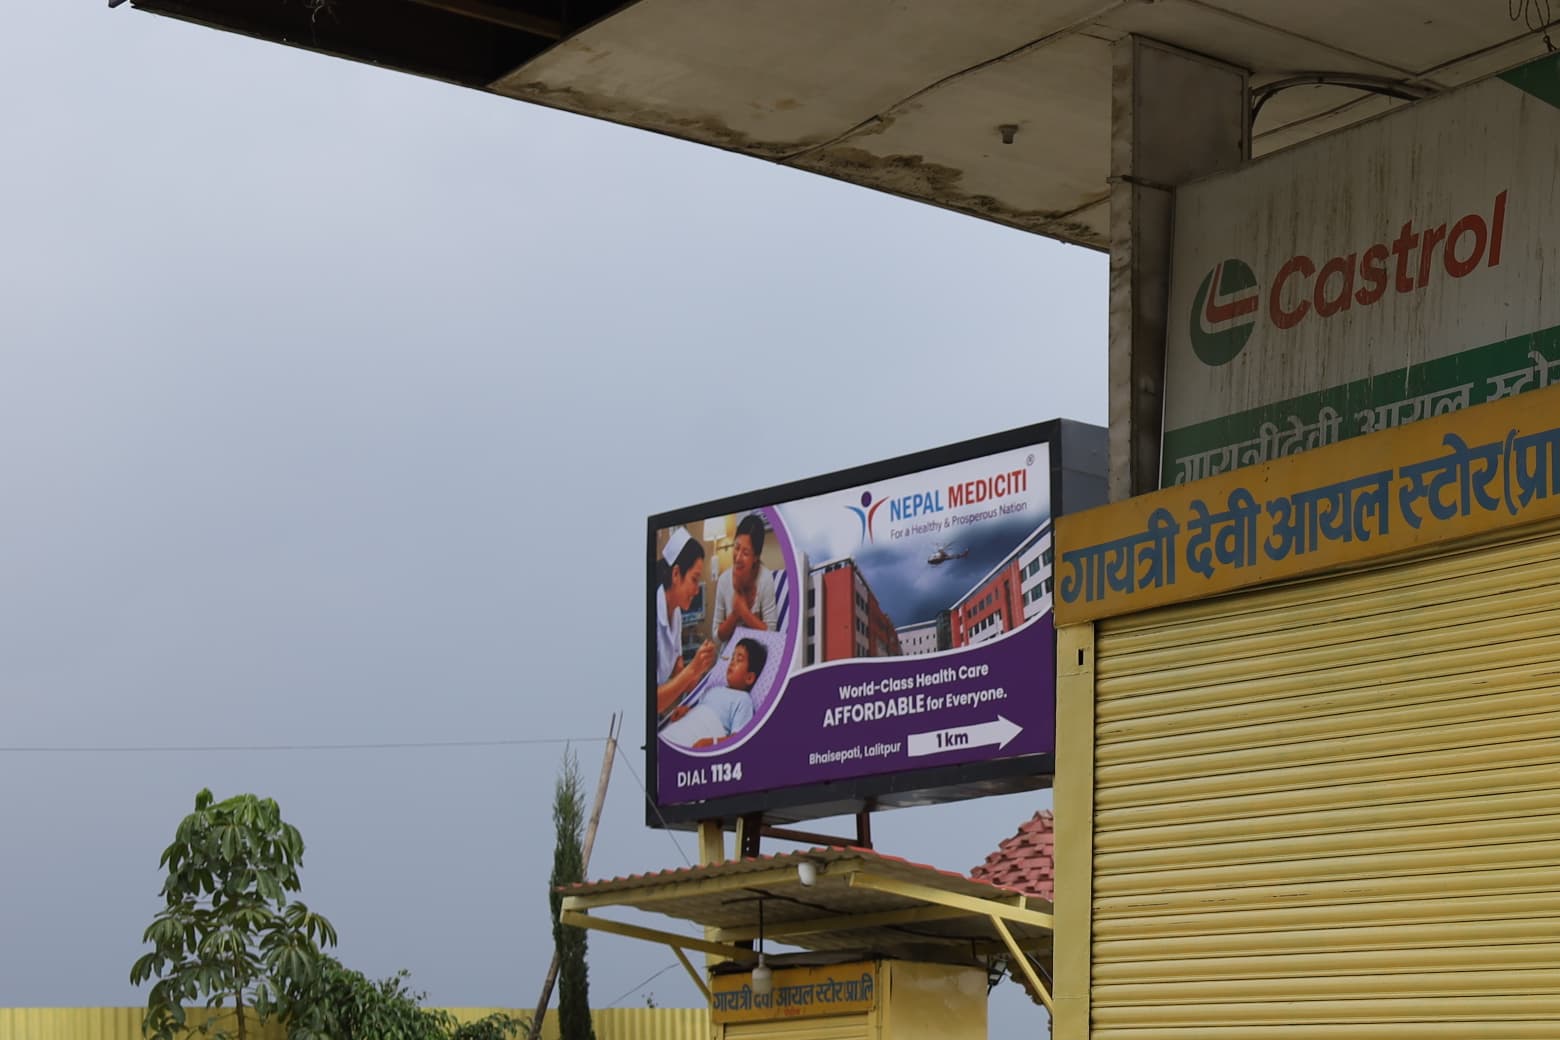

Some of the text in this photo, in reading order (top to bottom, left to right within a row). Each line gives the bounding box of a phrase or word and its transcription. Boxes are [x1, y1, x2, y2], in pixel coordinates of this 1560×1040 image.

[1269, 189, 1508, 330] Castrol
[890, 468, 1027, 522] NEPAL MEDICITI
[890, 528, 904, 540] For
[911, 520, 942, 536] Healthy
[944, 518, 951, 528] &
[952, 507, 998, 527] Prosperous
[999, 501, 1027, 516] Nation
[1059, 507, 1181, 604] गायत्री
[1185, 487, 1262, 581] देवी
[1263, 469, 1393, 563] आयल
[839, 663, 989, 700] World-Class Health Care
[822, 686, 1008, 728] AFFORDABLE for Everyone.
[809, 741, 902, 765] Bhaisepati, Lalitpur
[677, 762, 743, 788] DIAL 1134
[713, 983, 752, 1012] गायत्री
[775, 983, 814, 1007] आयल
[815, 977, 844, 1003] स्टोर
